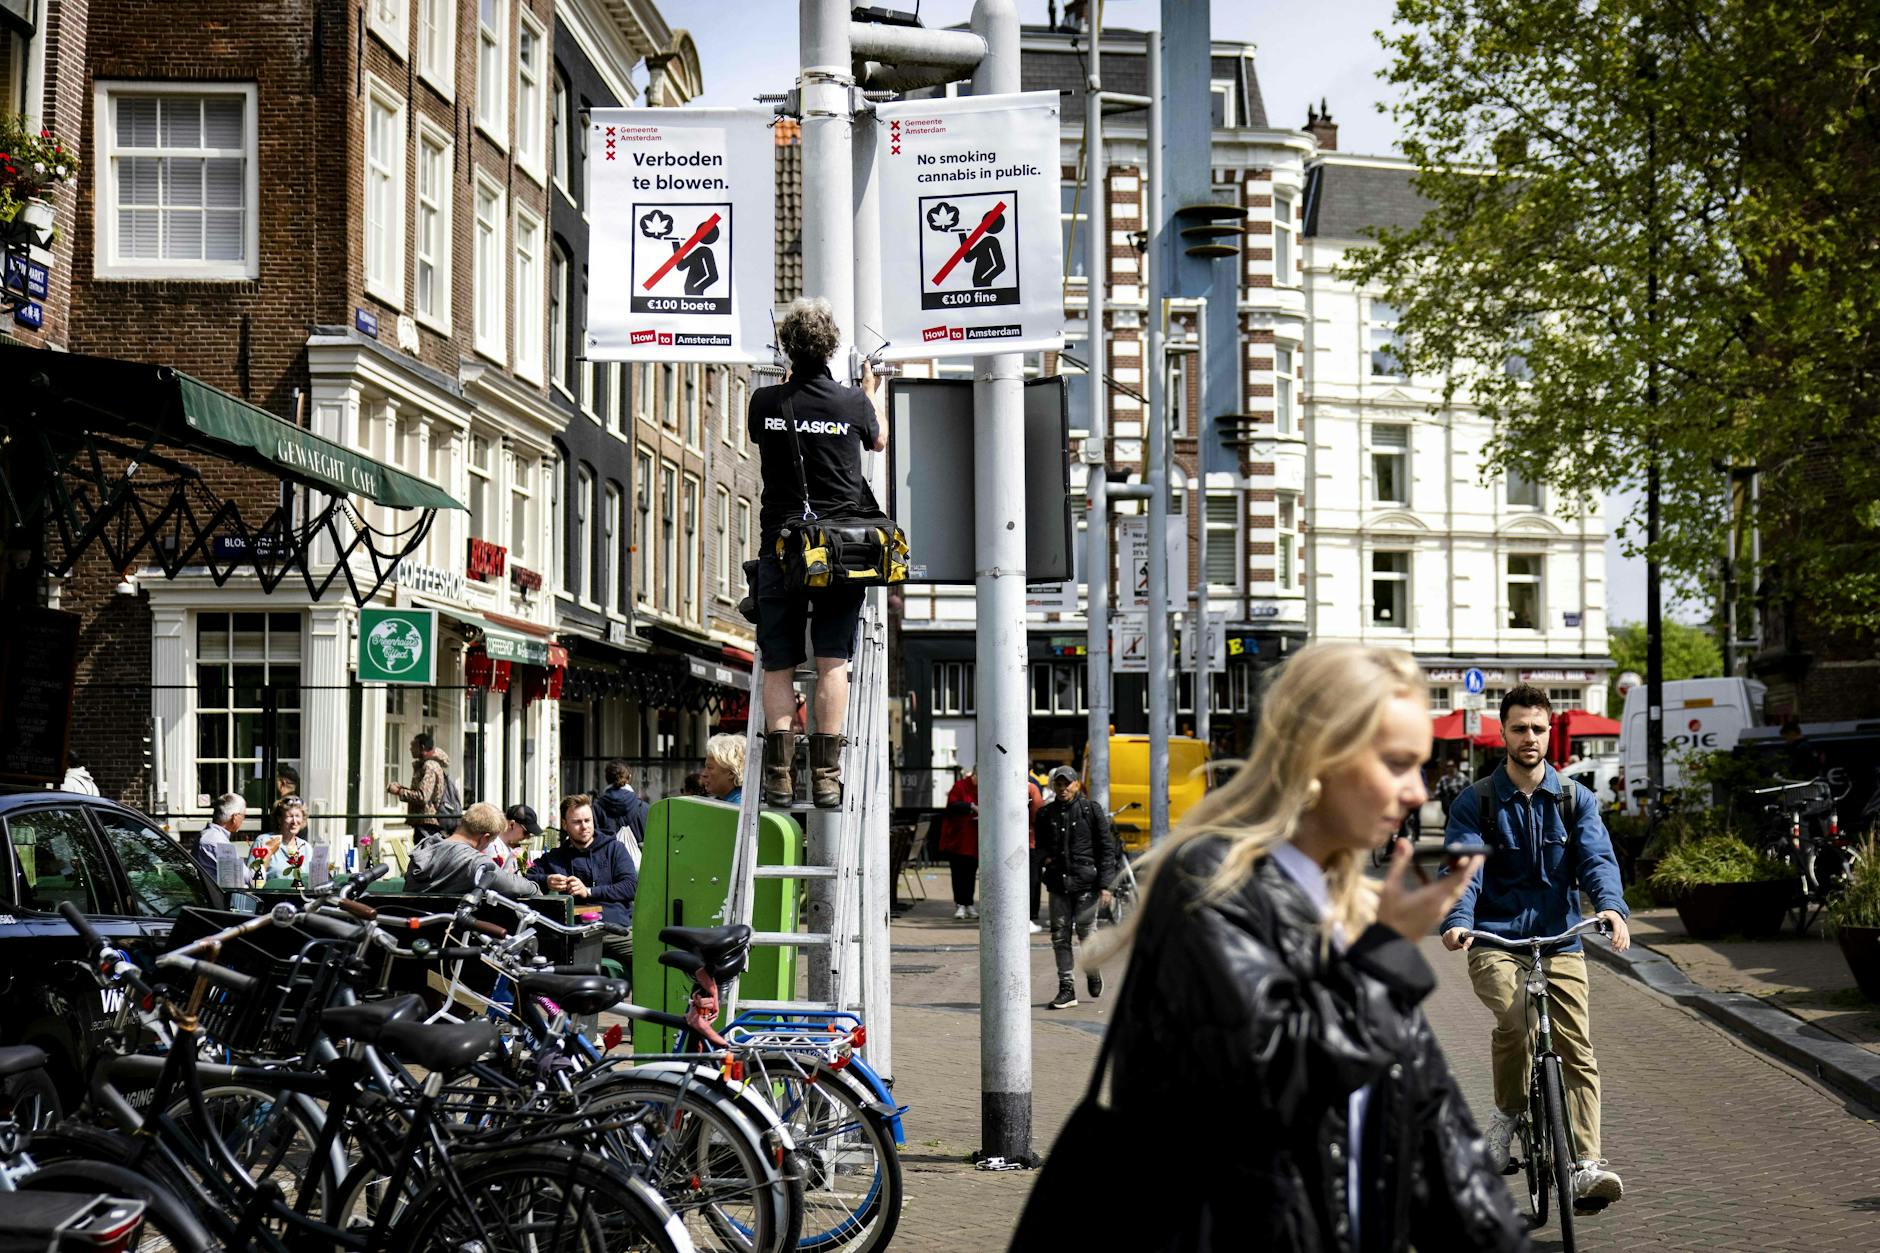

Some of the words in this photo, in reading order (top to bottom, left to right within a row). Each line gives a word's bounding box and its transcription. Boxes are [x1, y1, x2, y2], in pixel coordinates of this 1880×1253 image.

[905, 117, 943, 127] Gemeente
[620, 126, 659, 134] Gemeente
[905, 125, 947, 135] Amsterdam
[620, 134, 662, 142] Amsterdam
[633, 152, 723, 167] Verboden
[917, 154, 936, 166] No
[940, 150, 996, 167] smoking
[917, 167, 977, 183] cannabis
[979, 166, 992, 179] in
[995, 164, 1042, 182] public.
[632, 176, 651, 190] te
[656, 175, 729, 190] blowen.
[942, 293, 972, 305] €100
[973, 291, 997, 304] fine
[647, 299, 678, 311] €100
[680, 299, 717, 311] boete
[632, 333, 655, 344] How
[660, 335, 671, 345] to
[677, 335, 730, 346] Amsterdam
[924, 328, 946, 340] How
[951, 330, 962, 339] to
[968, 327, 1021, 338] Amsterdam
[277, 438, 346, 483] GEWAEGHT
[396, 559, 466, 600] COFFEESHOP
